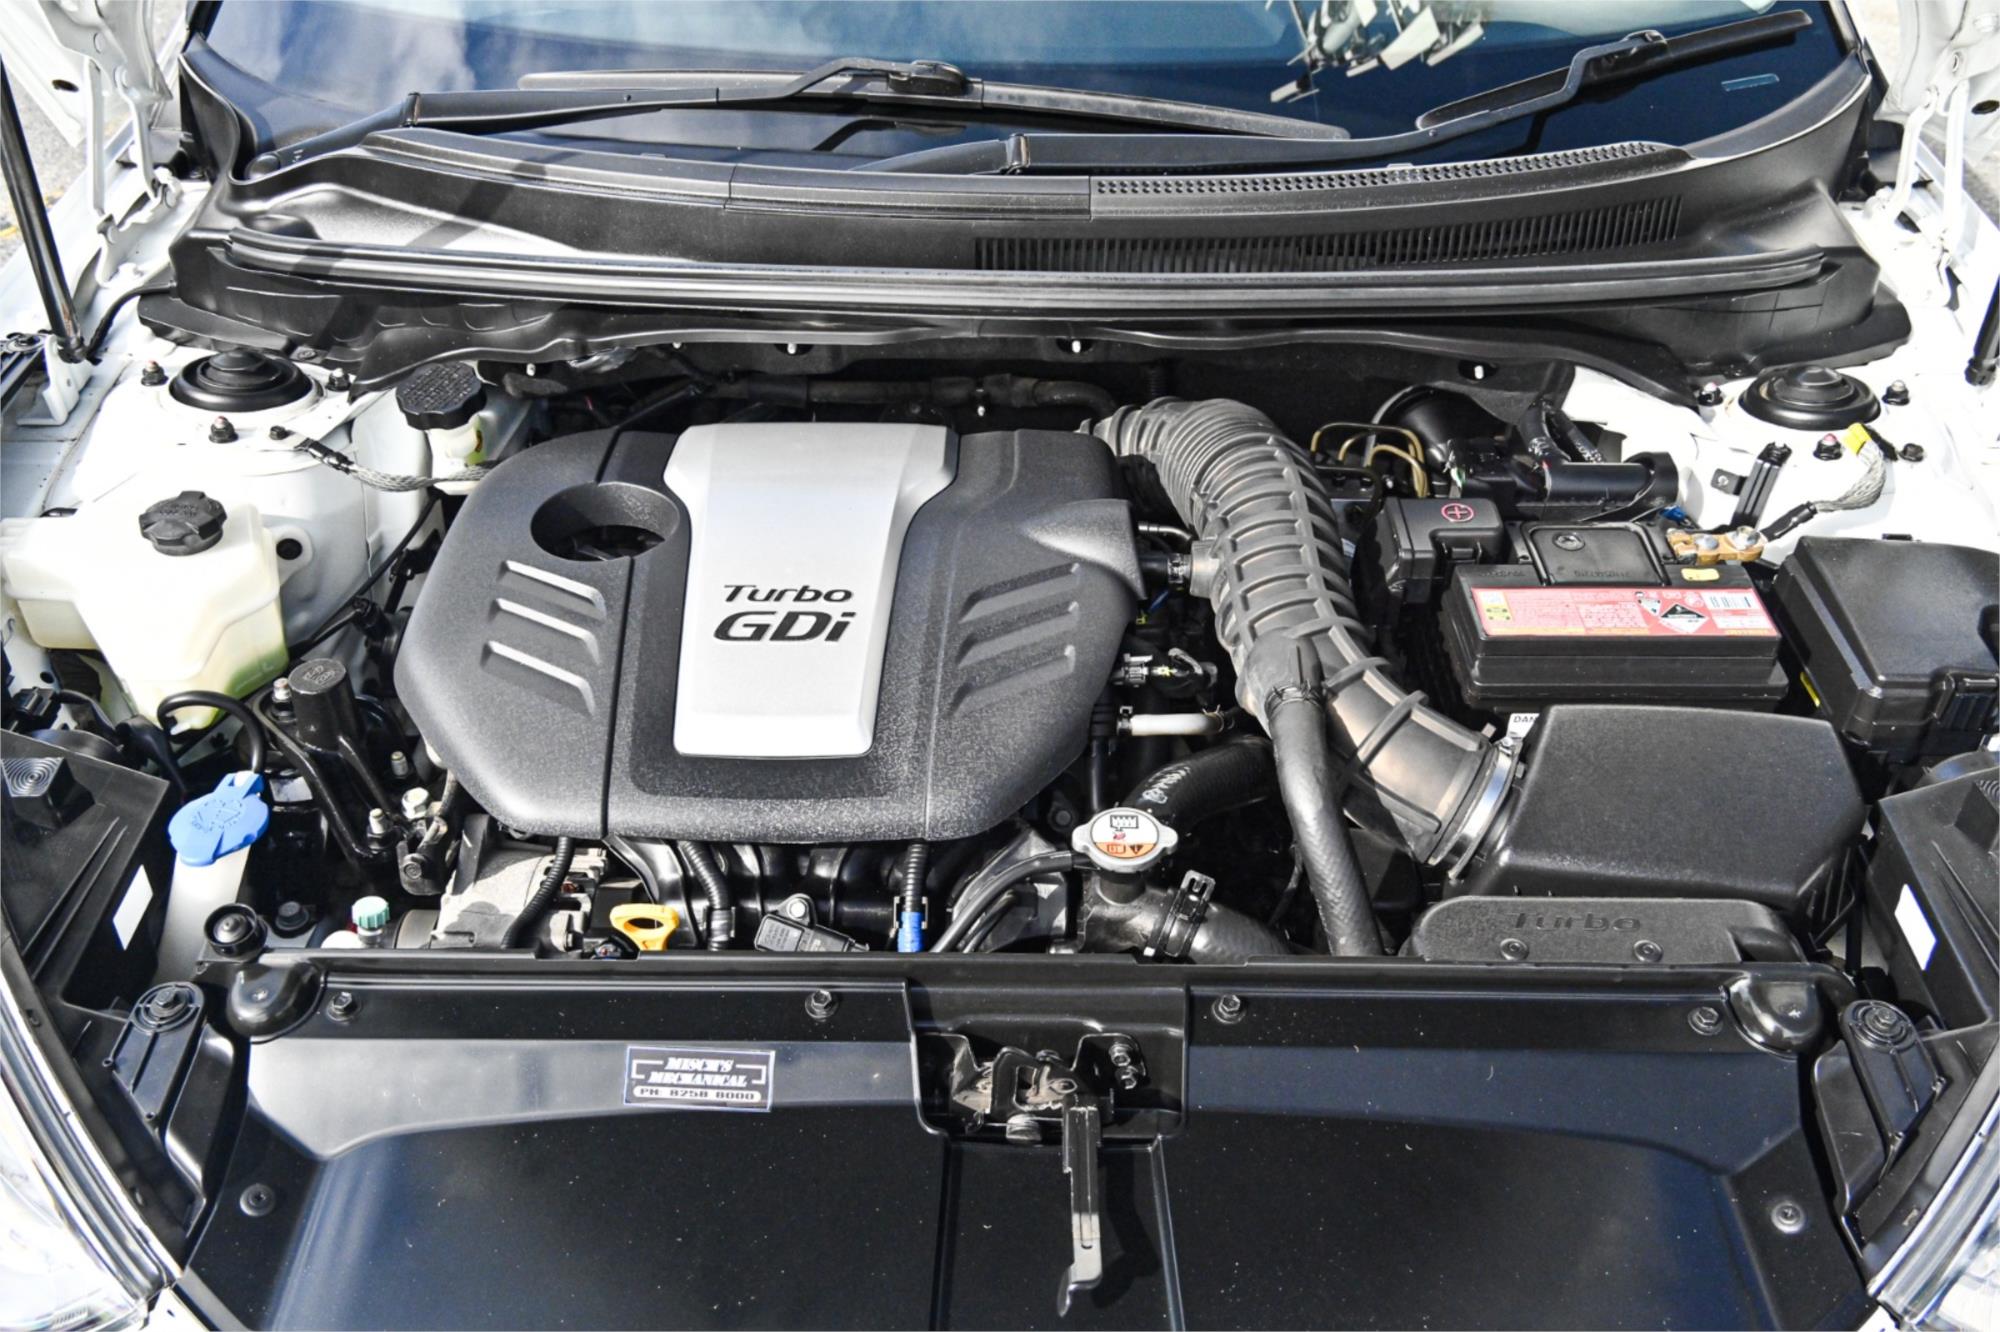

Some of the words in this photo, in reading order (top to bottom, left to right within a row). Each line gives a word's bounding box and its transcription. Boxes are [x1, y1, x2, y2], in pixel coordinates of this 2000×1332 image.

[724, 584, 854, 602] Turbo
[713, 610, 857, 642] GDi
[1506, 911, 1641, 932] Turbo
[647, 1071, 748, 1087] MECHANICAL
